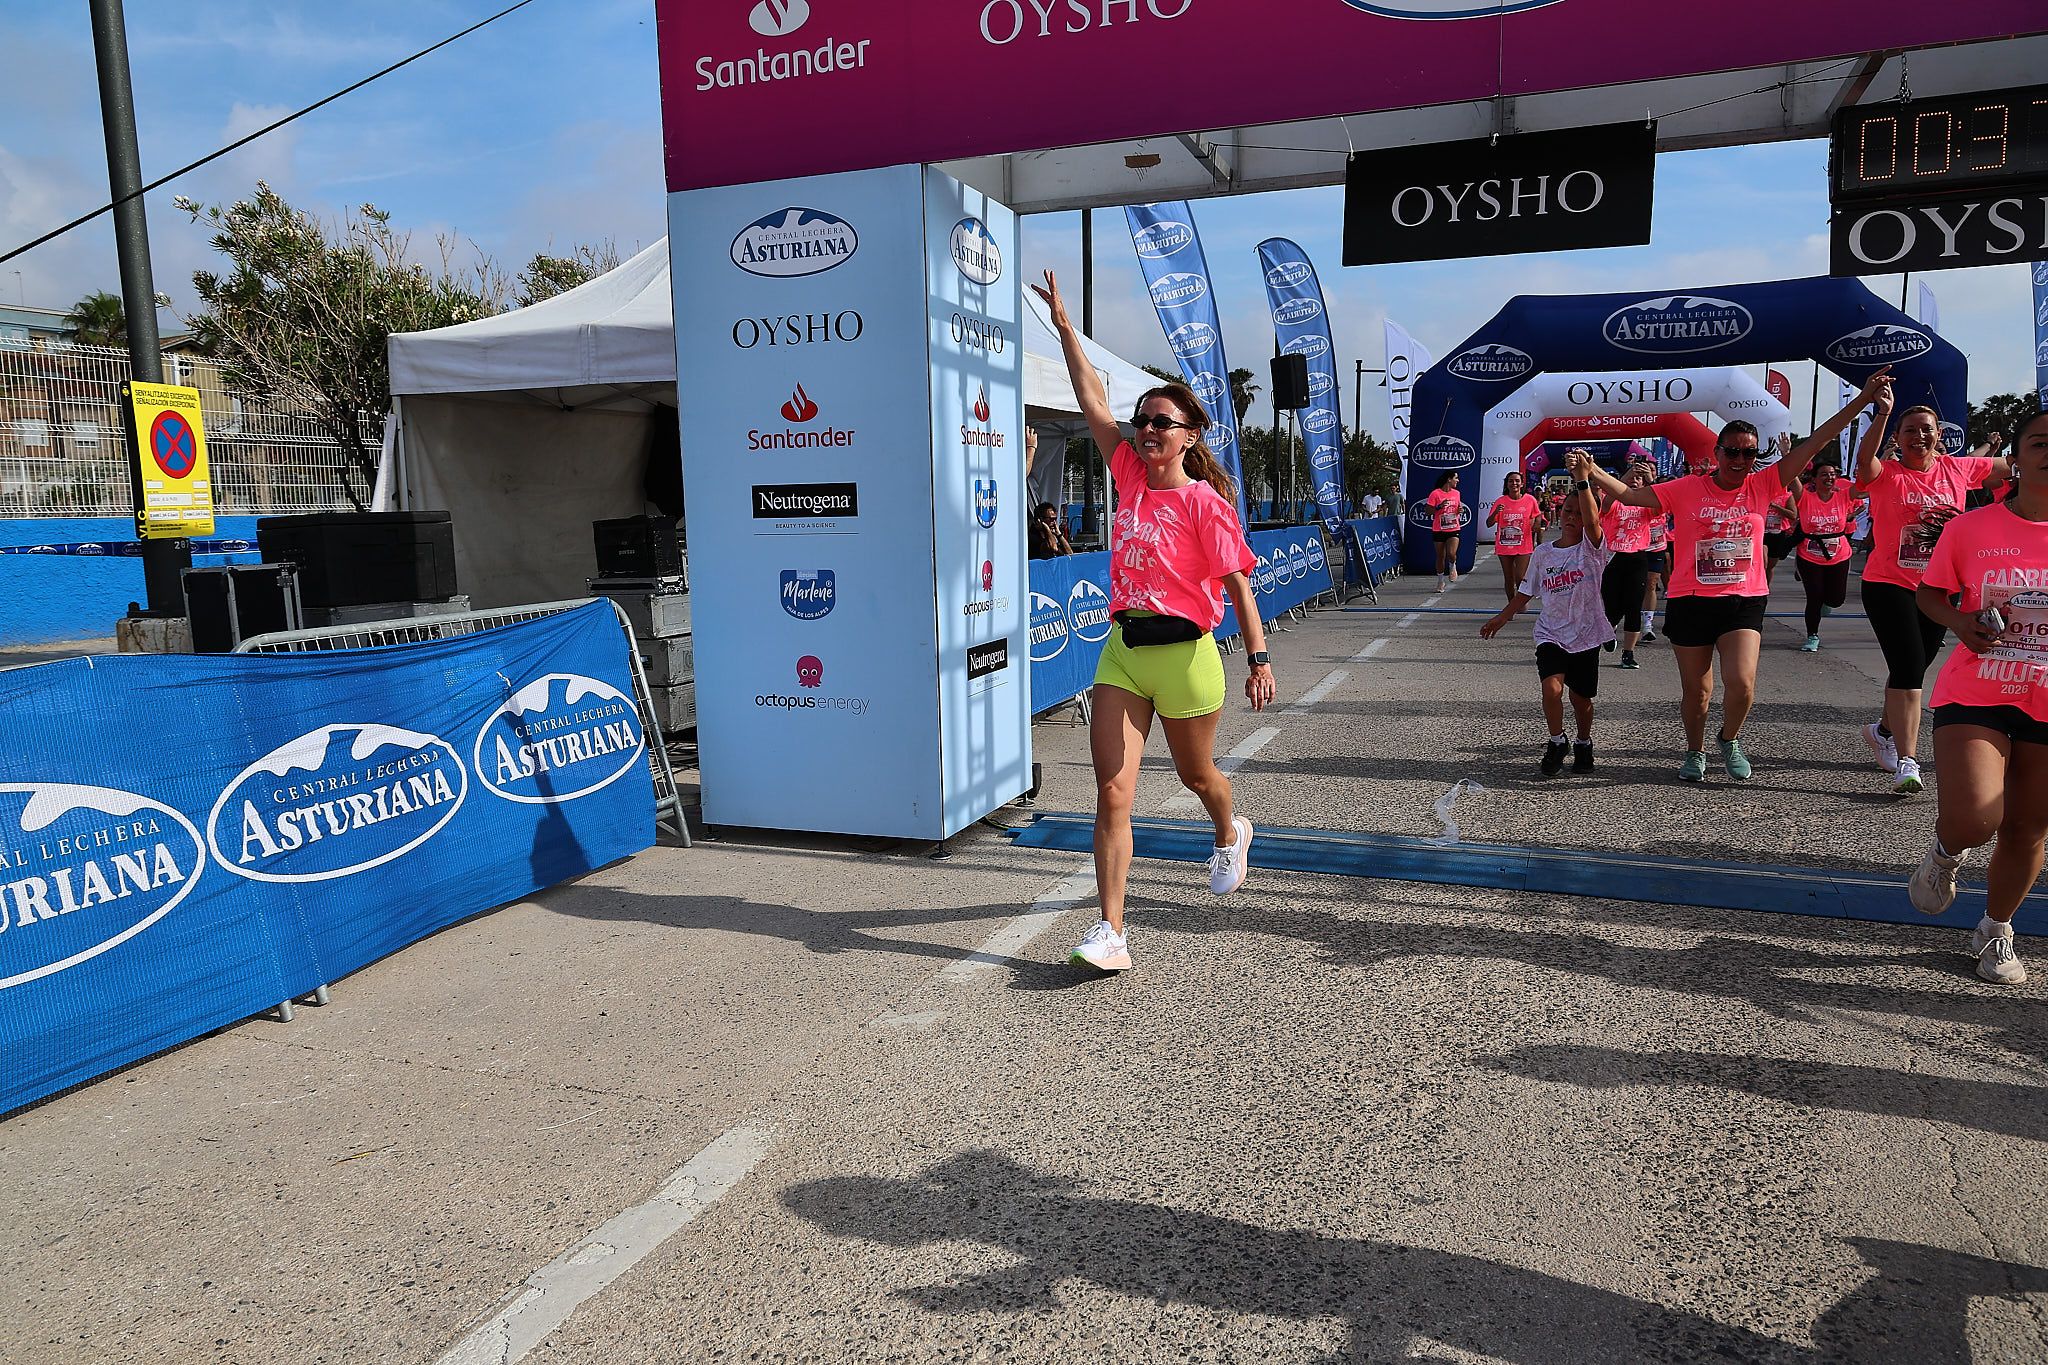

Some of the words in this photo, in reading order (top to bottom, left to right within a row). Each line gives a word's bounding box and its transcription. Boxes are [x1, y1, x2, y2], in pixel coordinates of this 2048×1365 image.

[696, 37, 871, 91] Santander
[1860, 100, 2048, 181] 00:3
[1391, 170, 1604, 228] OYSHO
[758, 231, 798, 241] CENTRAL
[802, 226, 844, 237] LECHERA
[740, 237, 849, 264] ASTURIANA
[954, 233, 998, 275] ASTURIANA
[1636, 312, 1684, 321] CENTRAL
[1688, 309, 1737, 318] LECHERA
[732, 309, 863, 349] OYSHO
[951, 312, 1004, 355] OYSHO
[1613, 316, 1741, 340] ASTURIANA
[1835, 340, 1927, 358] ASTURIANA
[1452, 358, 1525, 372] ASTURIANA
[1567, 377, 1692, 405] OYSHO
[1496, 410, 1532, 419] OYSHO
[1728, 399, 1768, 409] OYSHO
[1553, 417, 1587, 429] Sports
[1602, 414, 1658, 426] Santander
[747, 426, 855, 451] Santander
[960, 424, 1005, 448] Santander
[1415, 447, 1471, 462] ASTURIANA
[1481, 456, 1513, 465] OYSHO
[759, 491, 850, 513] Neutrogena
[1714, 558, 1736, 568] 016
[1977, 548, 2021, 559] OYSHO
[783, 580, 833, 607] Marlene
[814, 606, 829, 618] ALPES
[2019, 636, 2037, 644] 4471
[969, 649, 1005, 672] Neutrogena
[2001, 684, 2029, 695] 2026
[515, 715, 571, 738] CENTRAL
[574, 703, 625, 723] LECHERA
[496, 719, 638, 786] ASTURIANA
[273, 772, 358, 803] CENTRAL
[366, 750, 439, 781] LECHERA
[239, 768, 456, 865] ASTURIANA
[40, 818, 161, 860] LECHERA
